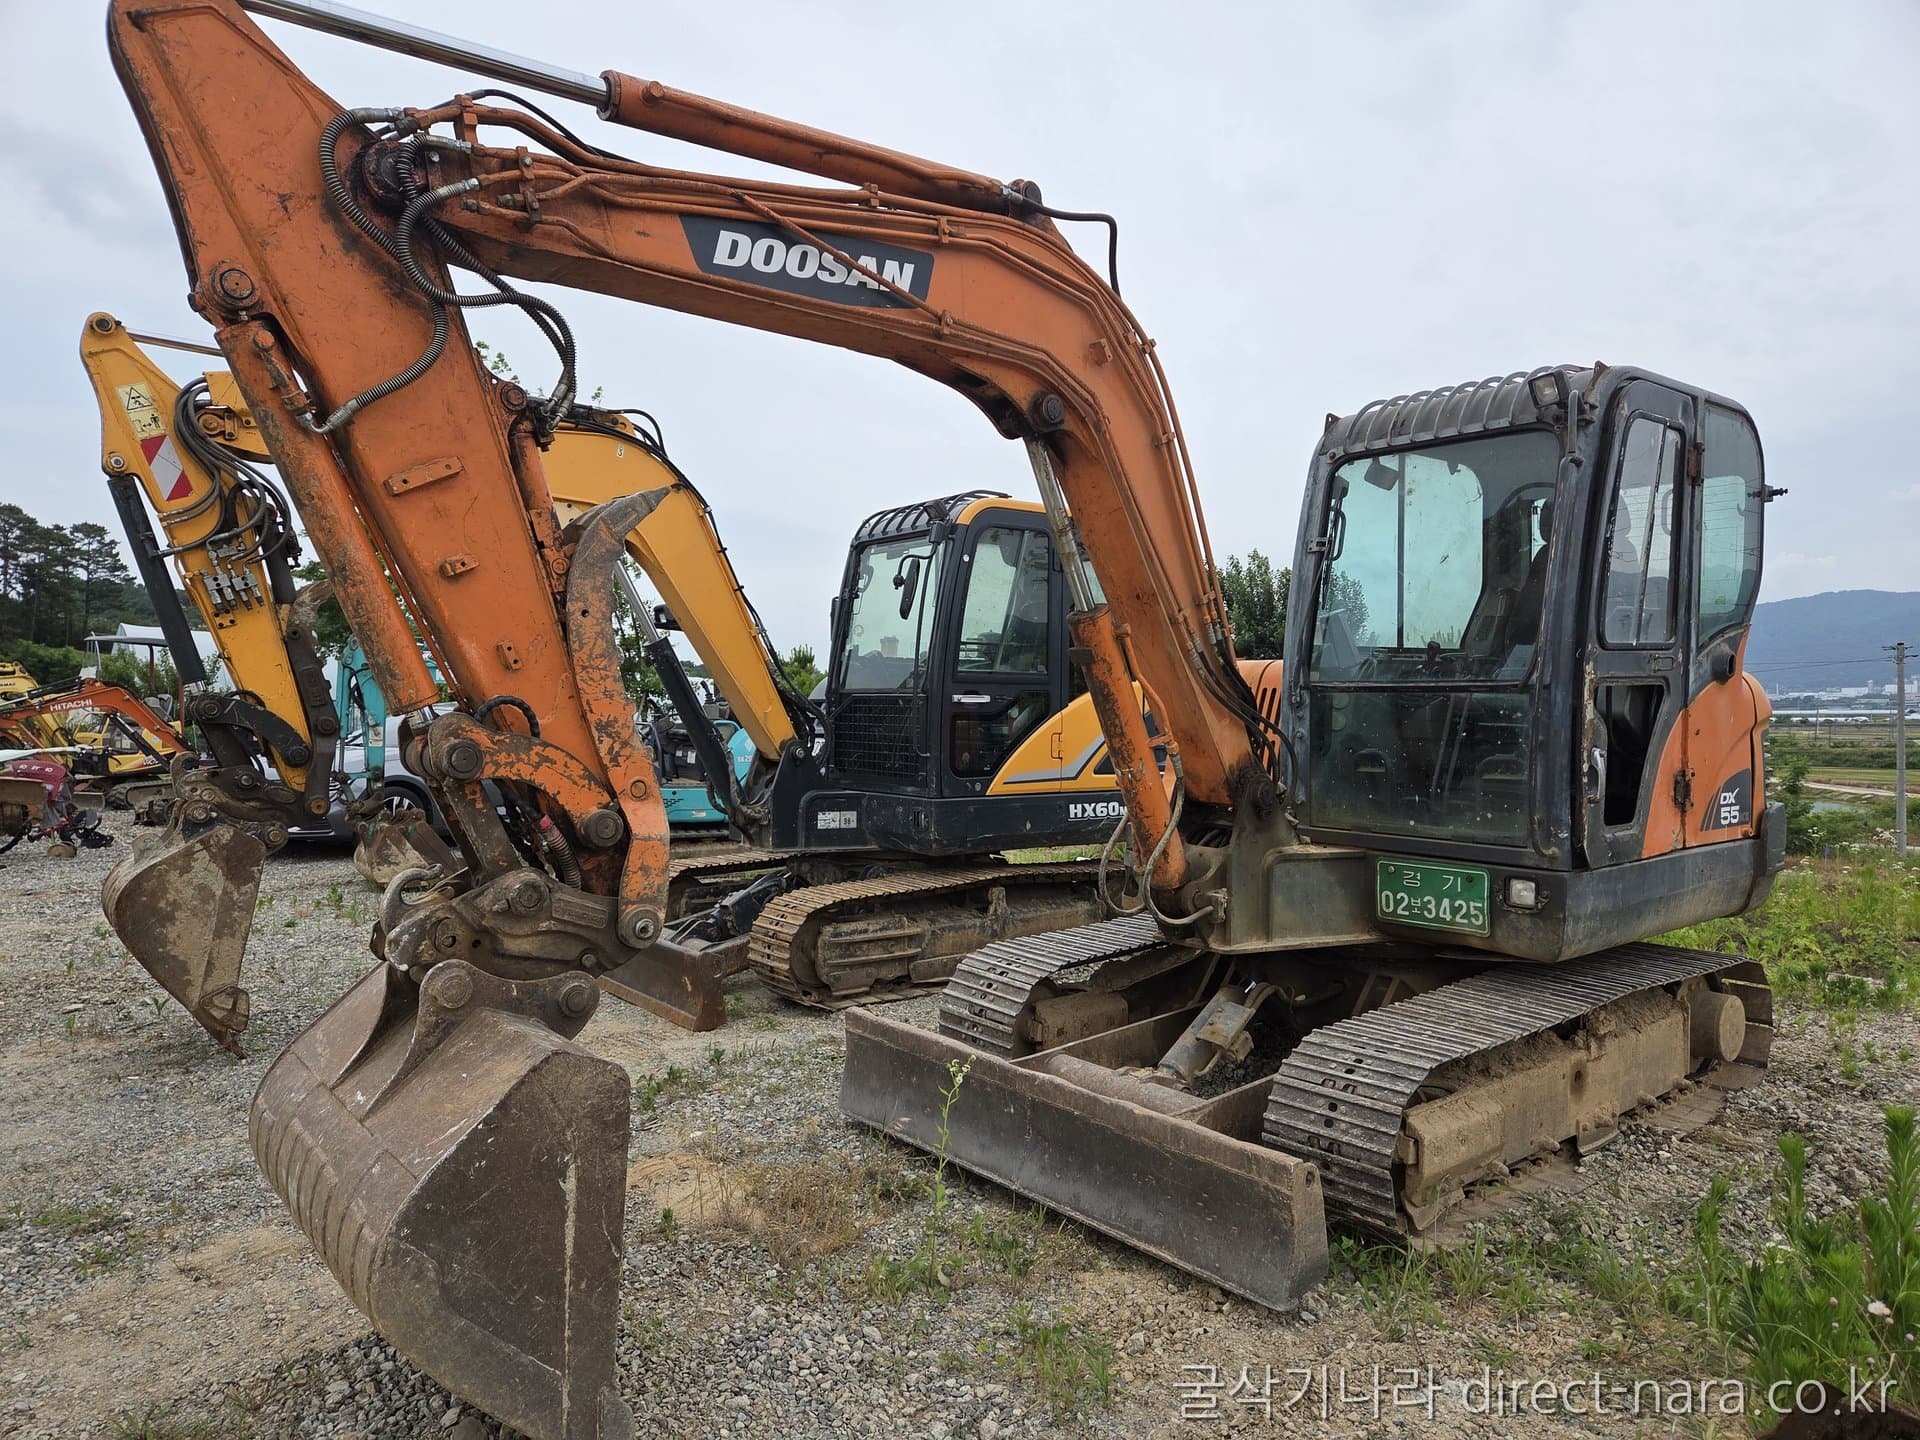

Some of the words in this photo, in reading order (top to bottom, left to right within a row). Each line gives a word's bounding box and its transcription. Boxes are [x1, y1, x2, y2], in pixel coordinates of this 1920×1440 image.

[713, 230, 914, 293] DOOSAN
[50, 698, 93, 712] HITACHI
[1720, 787, 1740, 805] DX
[1720, 805, 1740, 825] 55
